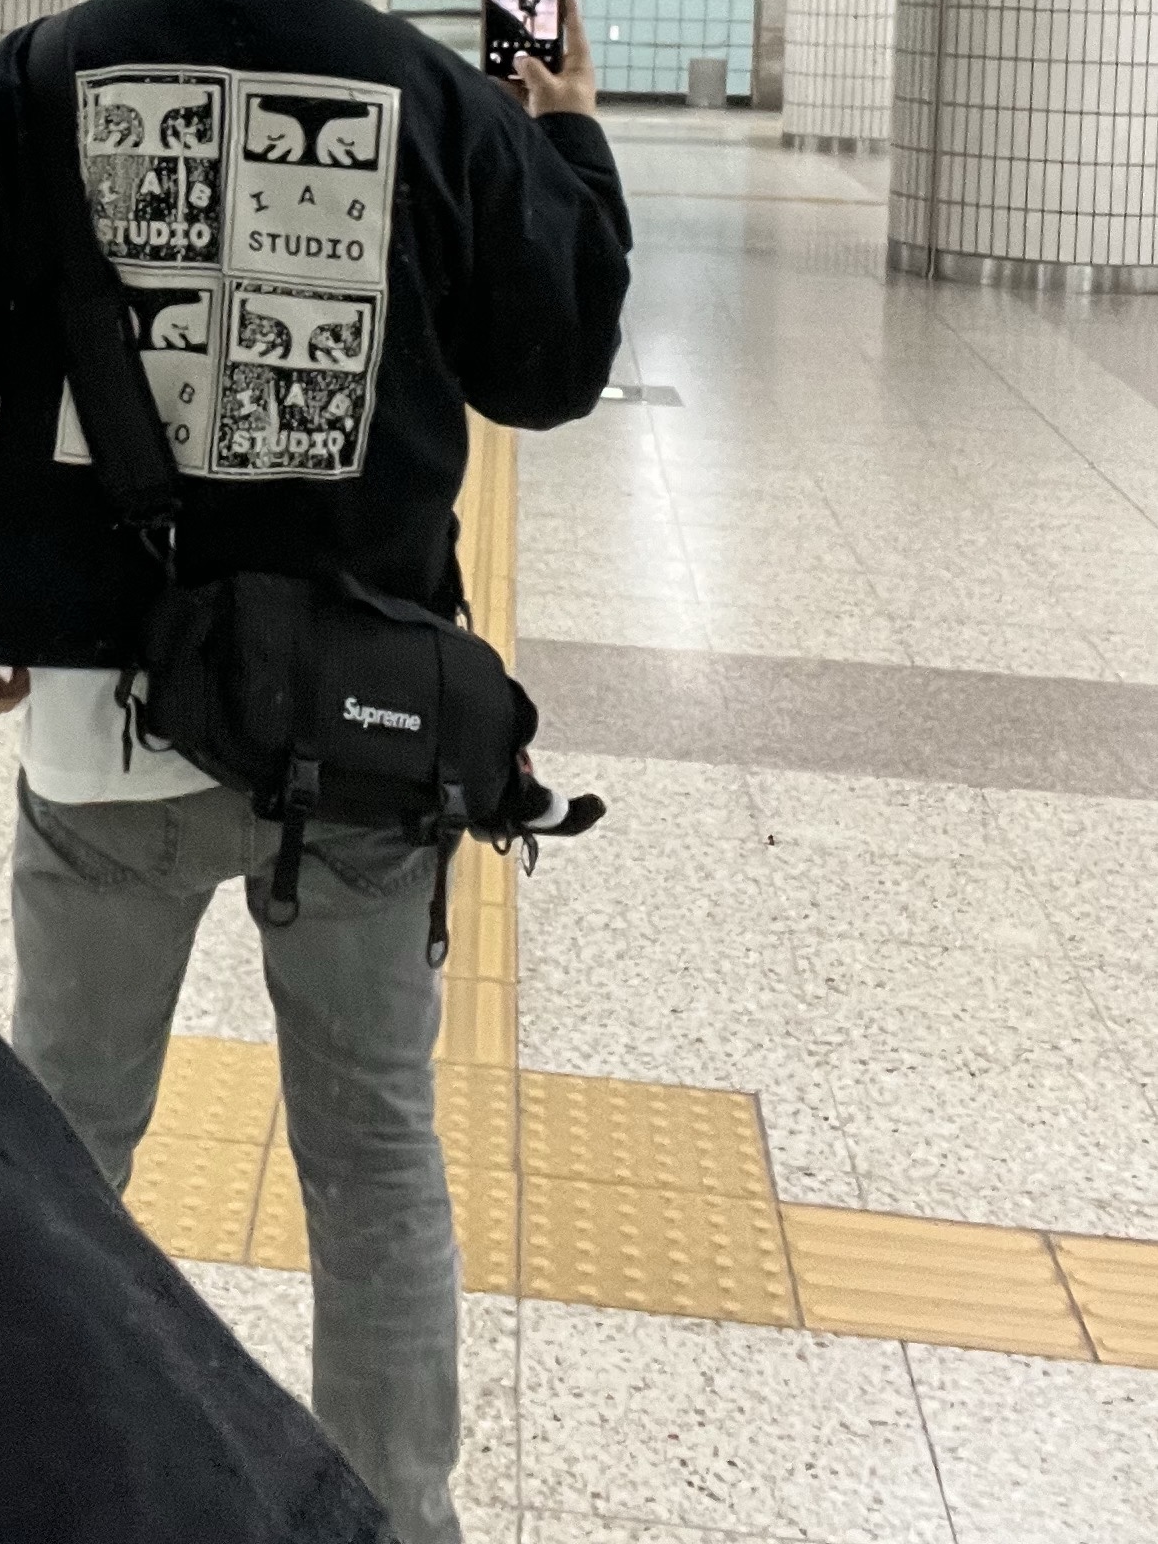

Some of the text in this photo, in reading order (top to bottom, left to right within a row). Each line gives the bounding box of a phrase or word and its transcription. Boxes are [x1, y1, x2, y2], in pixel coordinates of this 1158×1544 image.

[97, 218, 212, 248] STUDIO
[248, 230, 365, 262] STUDIO
[232, 430, 346, 454] STUDIO
[343, 697, 422, 731] Supreme
